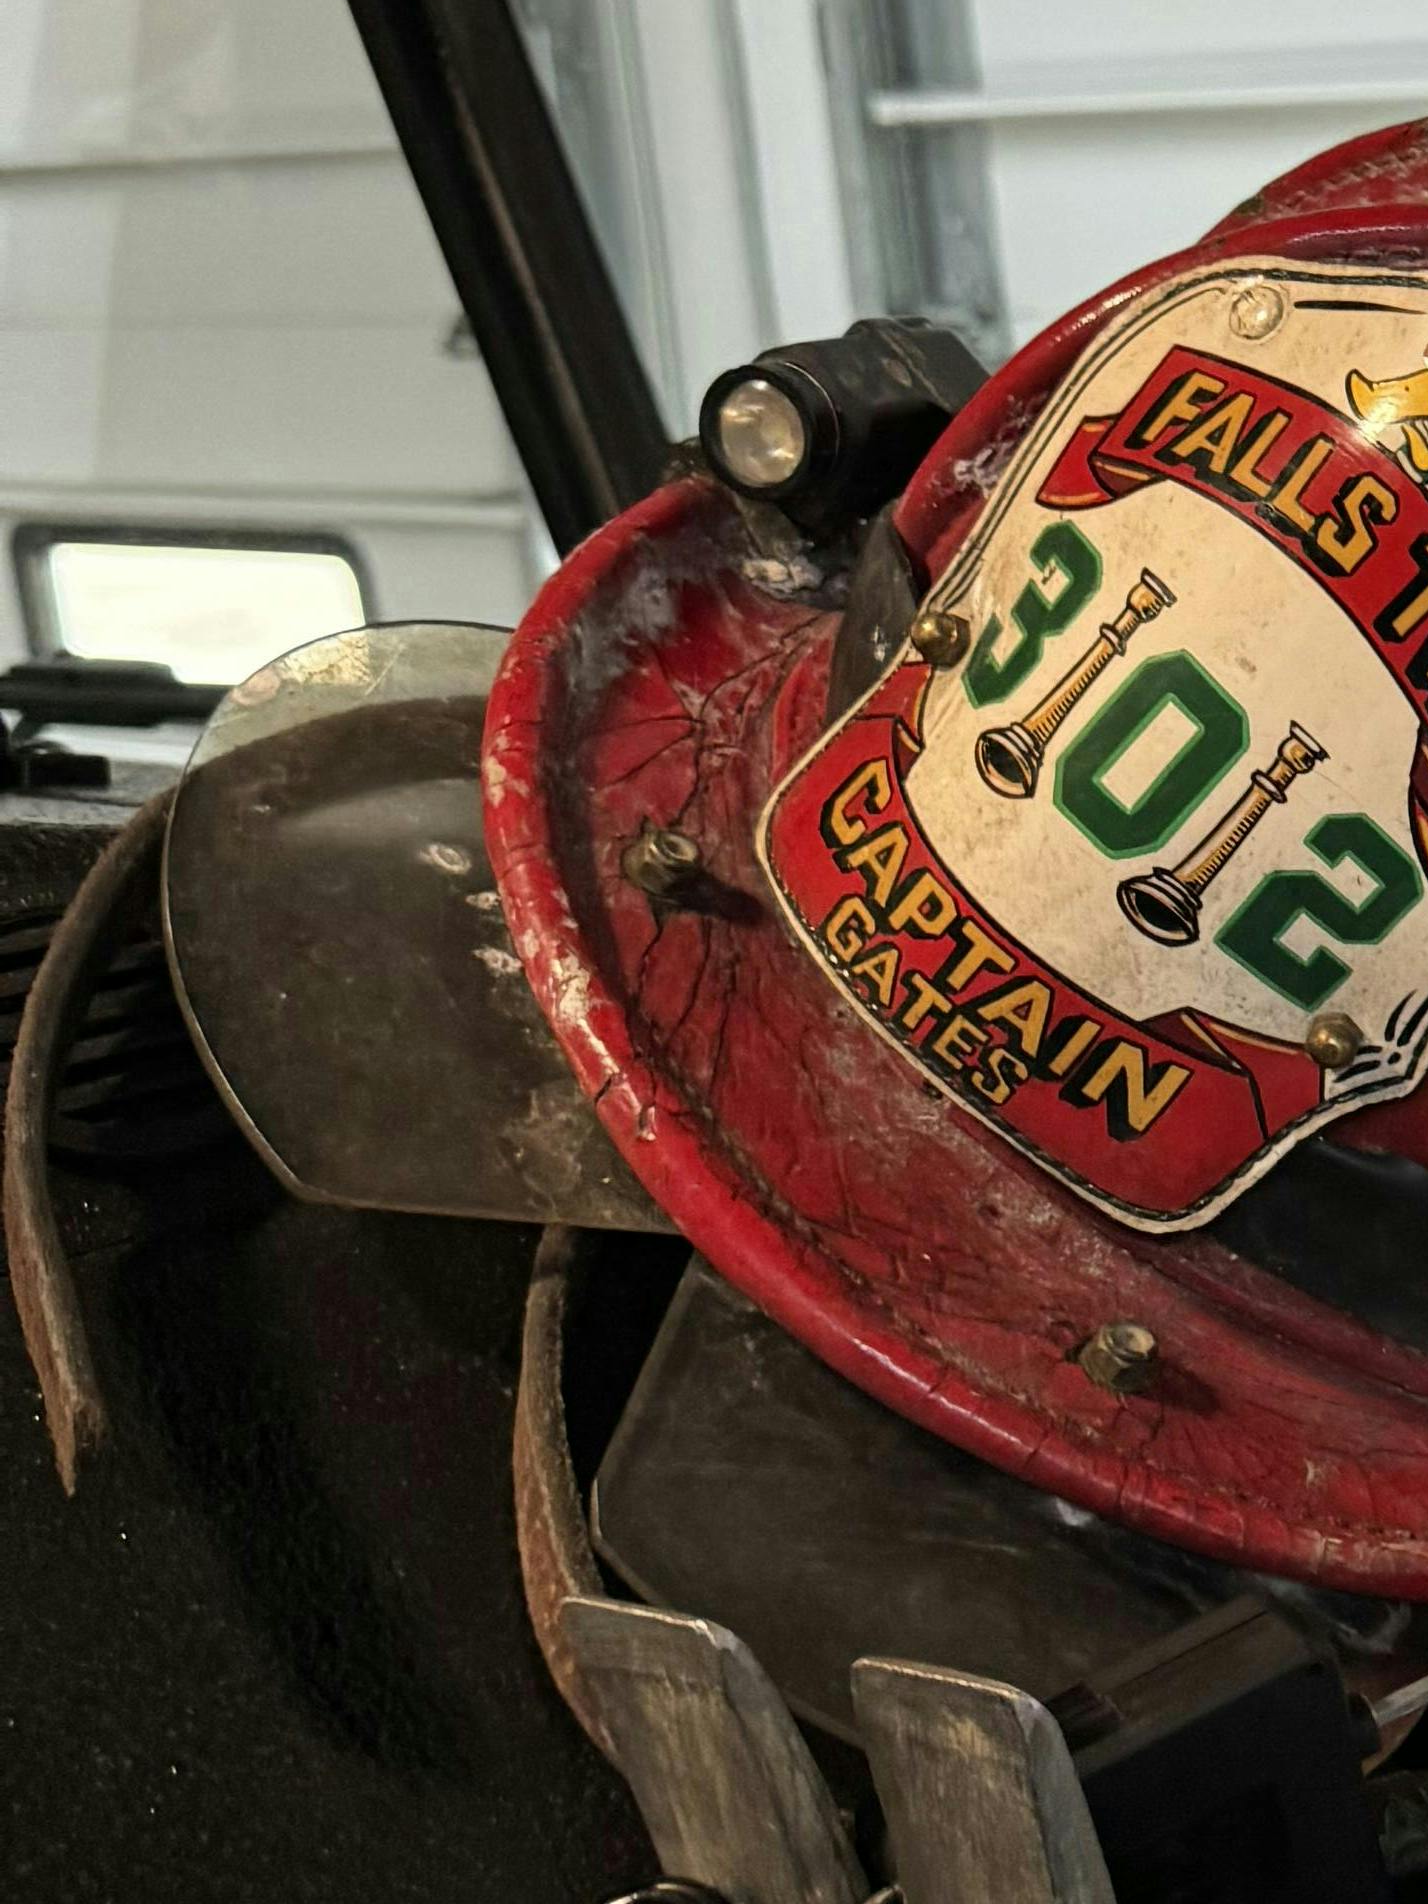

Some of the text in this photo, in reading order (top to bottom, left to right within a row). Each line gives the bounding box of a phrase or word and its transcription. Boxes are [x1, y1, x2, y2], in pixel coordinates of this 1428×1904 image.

[1138, 372, 1398, 577] FALLS
[819, 757, 1194, 1139] CAPTAIN
[826, 896, 1033, 1105] GATES
